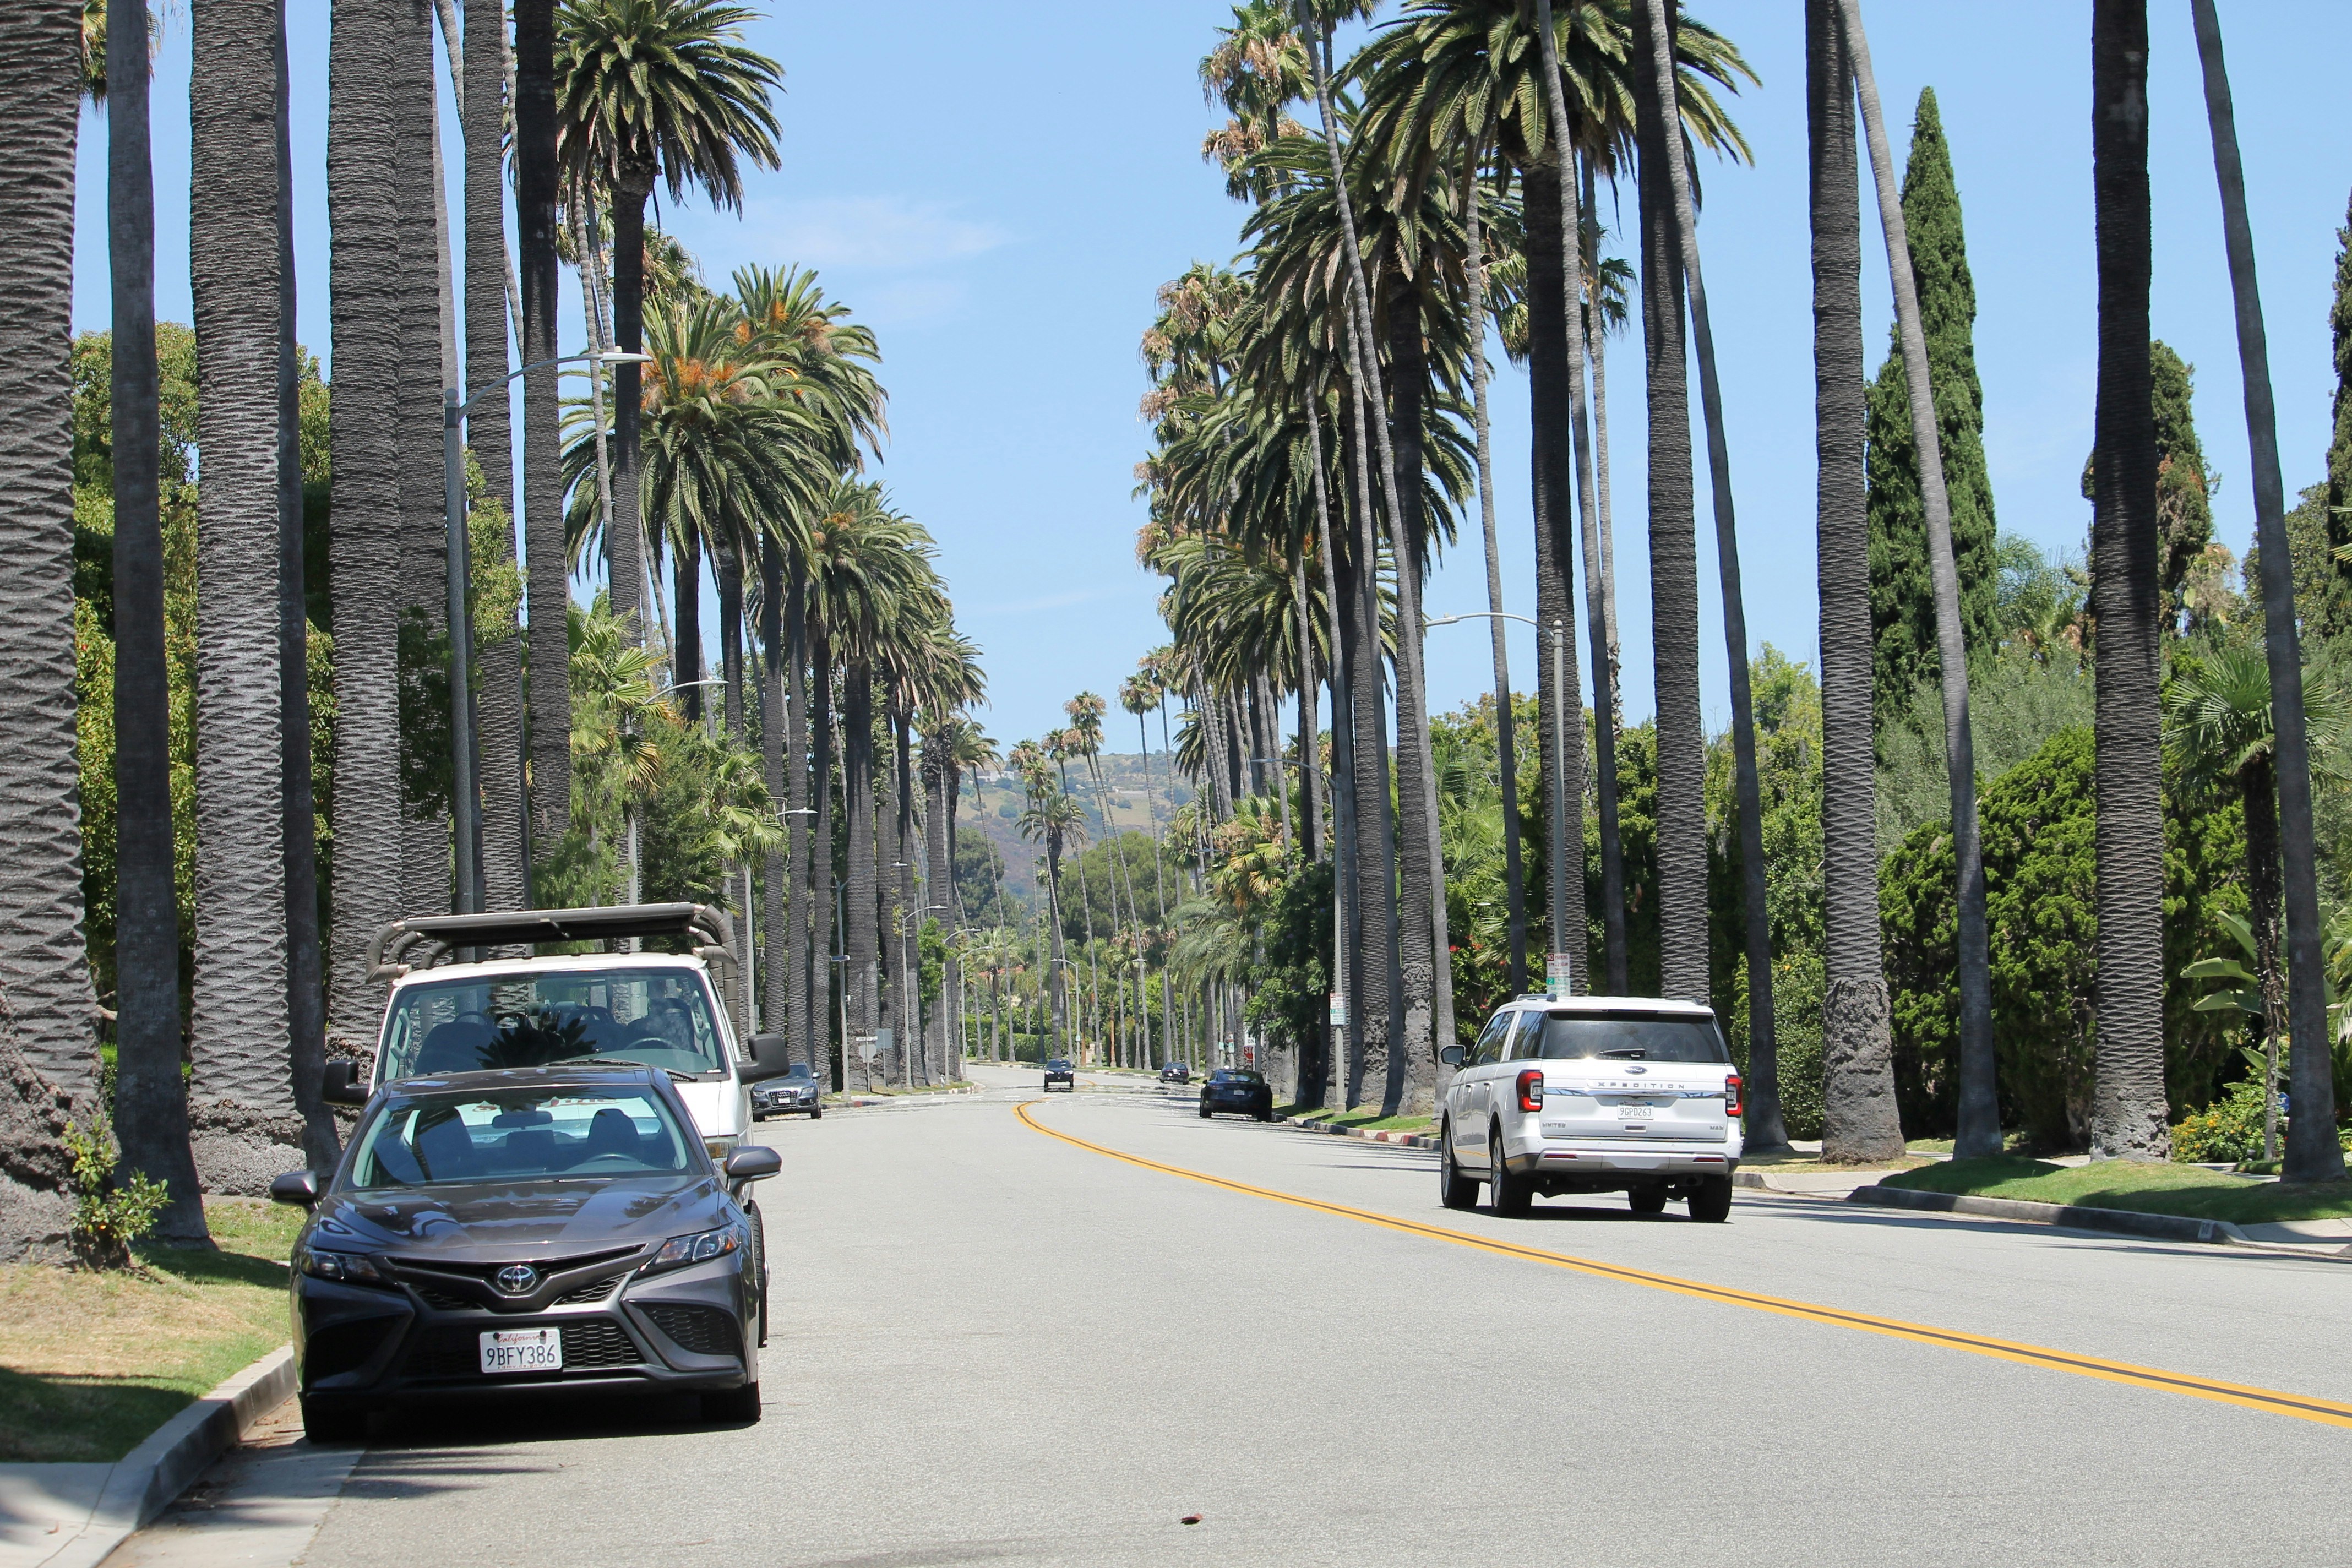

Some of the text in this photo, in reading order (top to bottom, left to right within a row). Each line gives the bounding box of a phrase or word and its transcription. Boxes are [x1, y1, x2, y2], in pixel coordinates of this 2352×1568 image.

[1620, 1107, 1652, 1117] 9GPD263
[497, 1333, 540, 1344] California
[487, 1344, 556, 1366] 9BFY386
